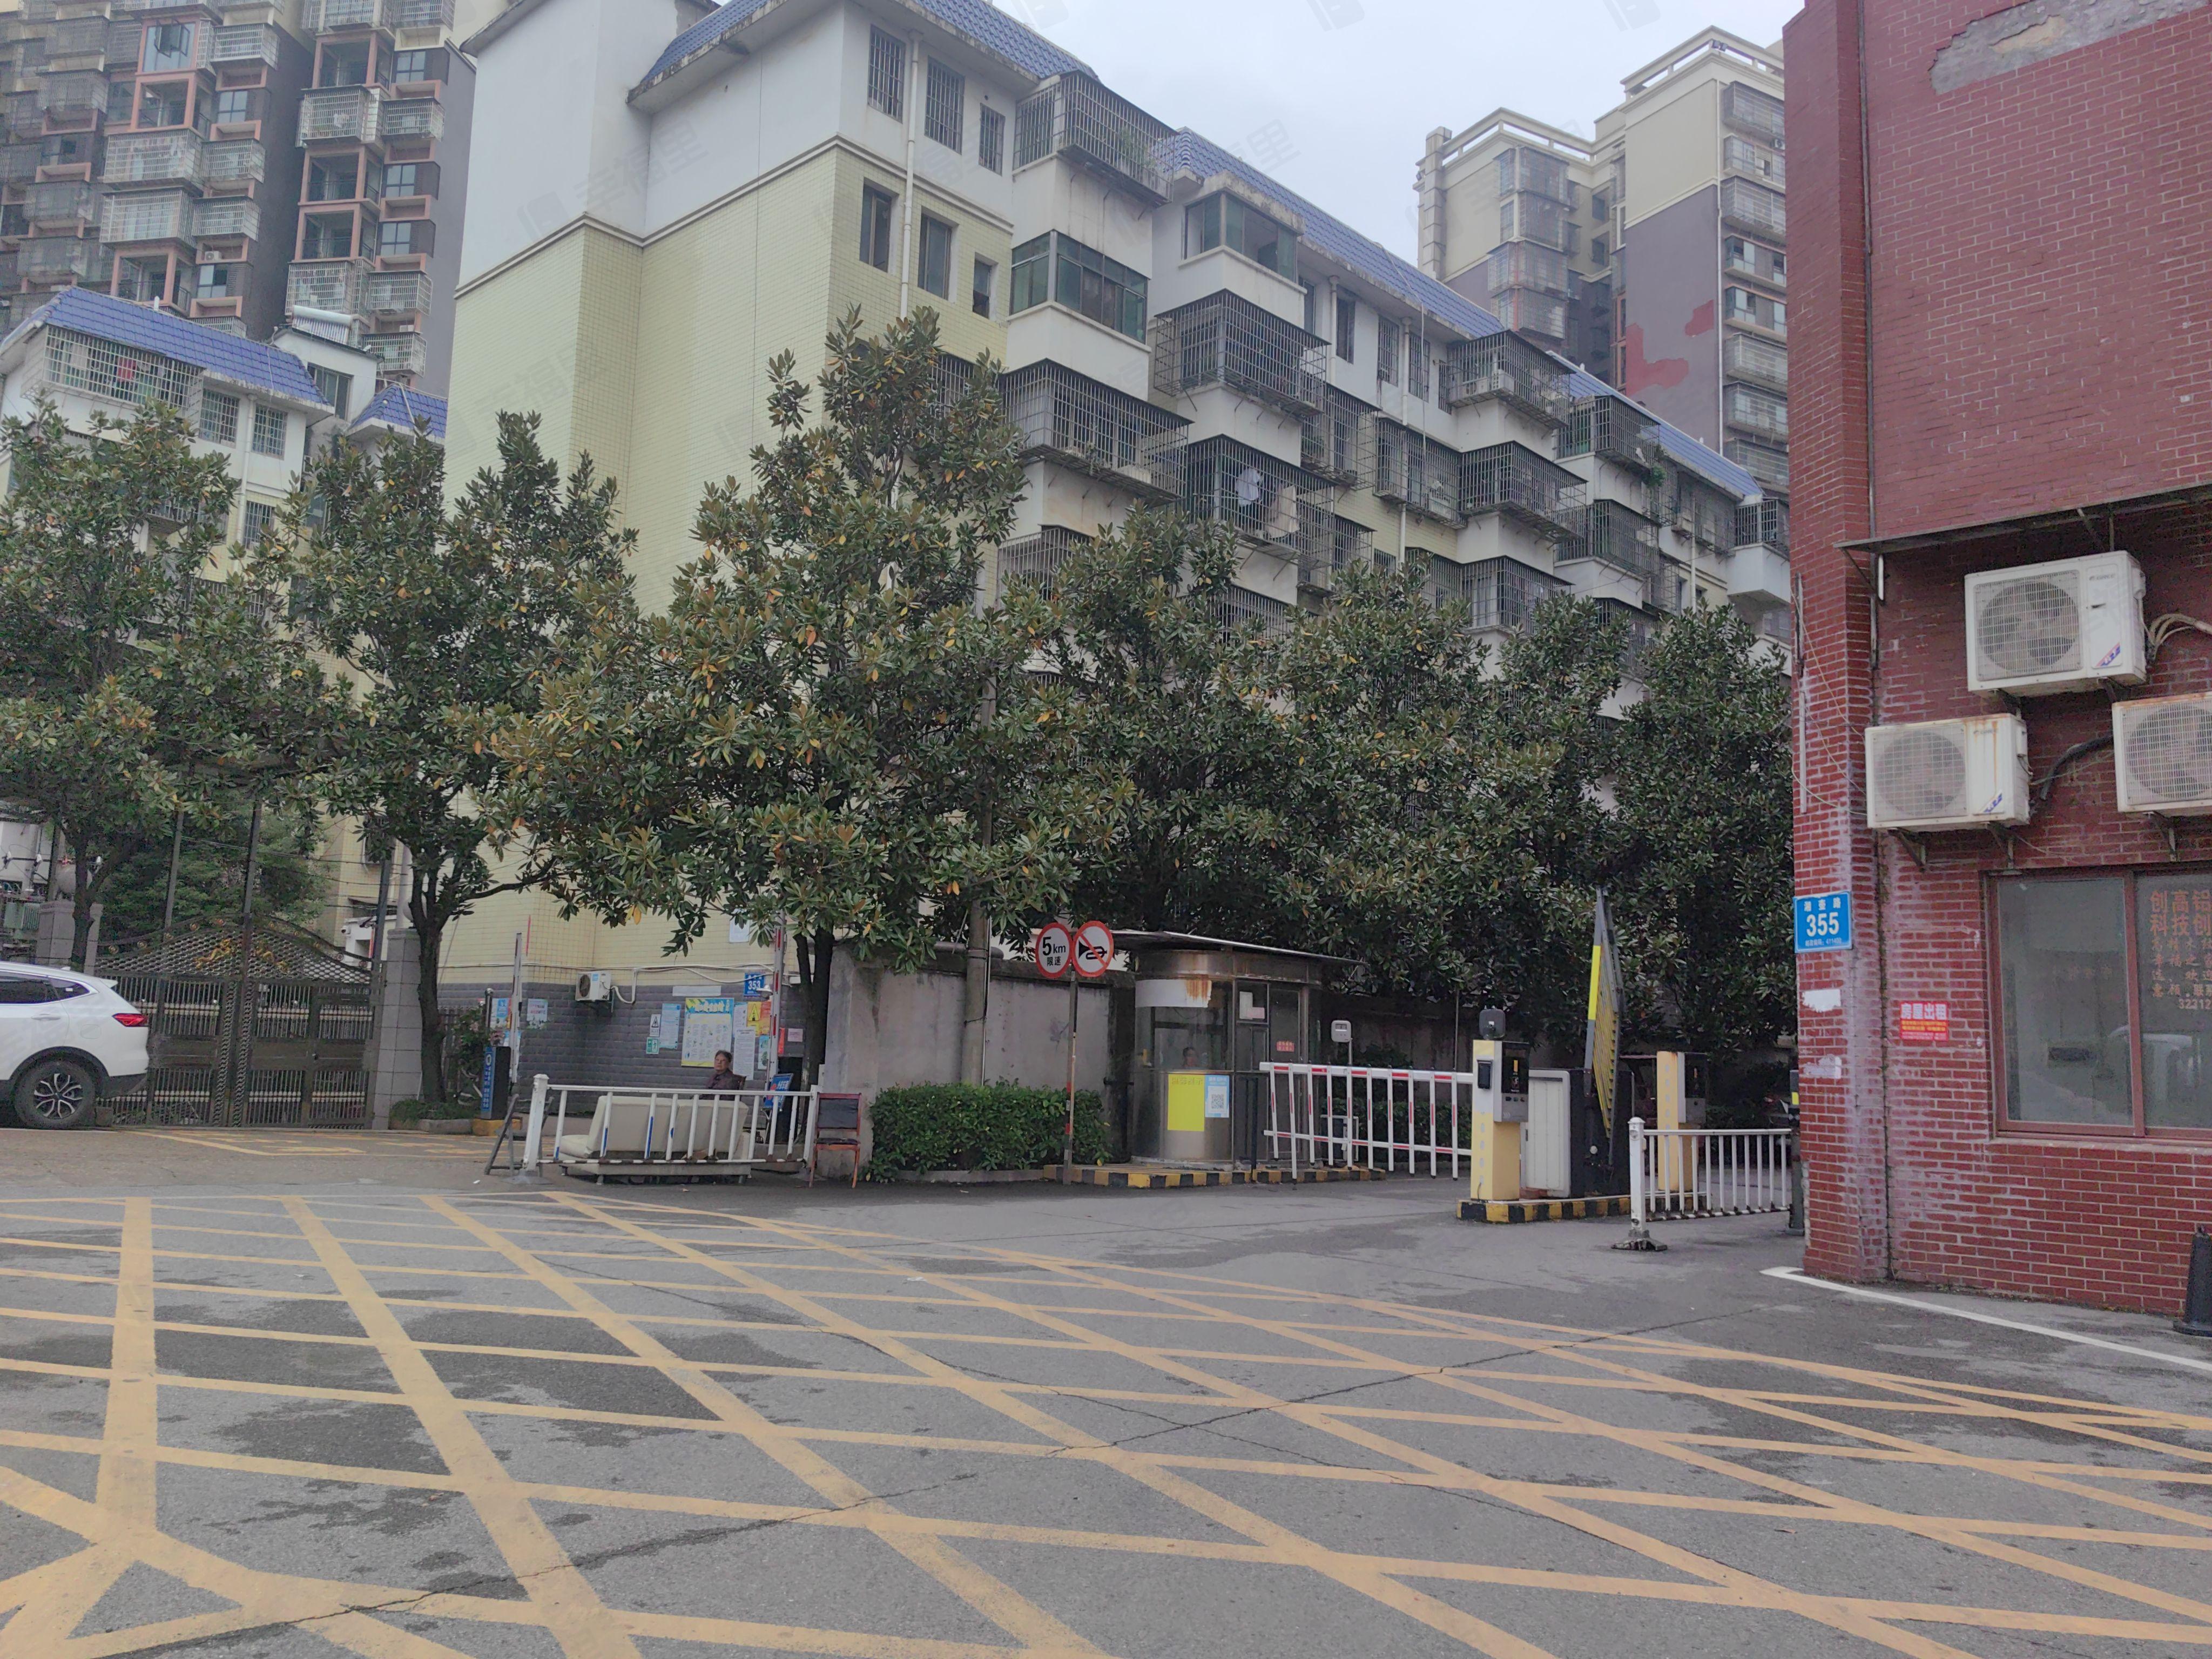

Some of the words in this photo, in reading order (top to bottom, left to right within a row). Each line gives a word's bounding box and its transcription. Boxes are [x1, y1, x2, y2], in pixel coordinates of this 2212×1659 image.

[1806, 912, 1839, 937] 355
[1042, 936, 1066, 956] 5km
[1047, 956, 1061, 966] 限速
[748, 980, 761, 990] 353
[1901, 1003, 1946, 1020] 房屋出租
